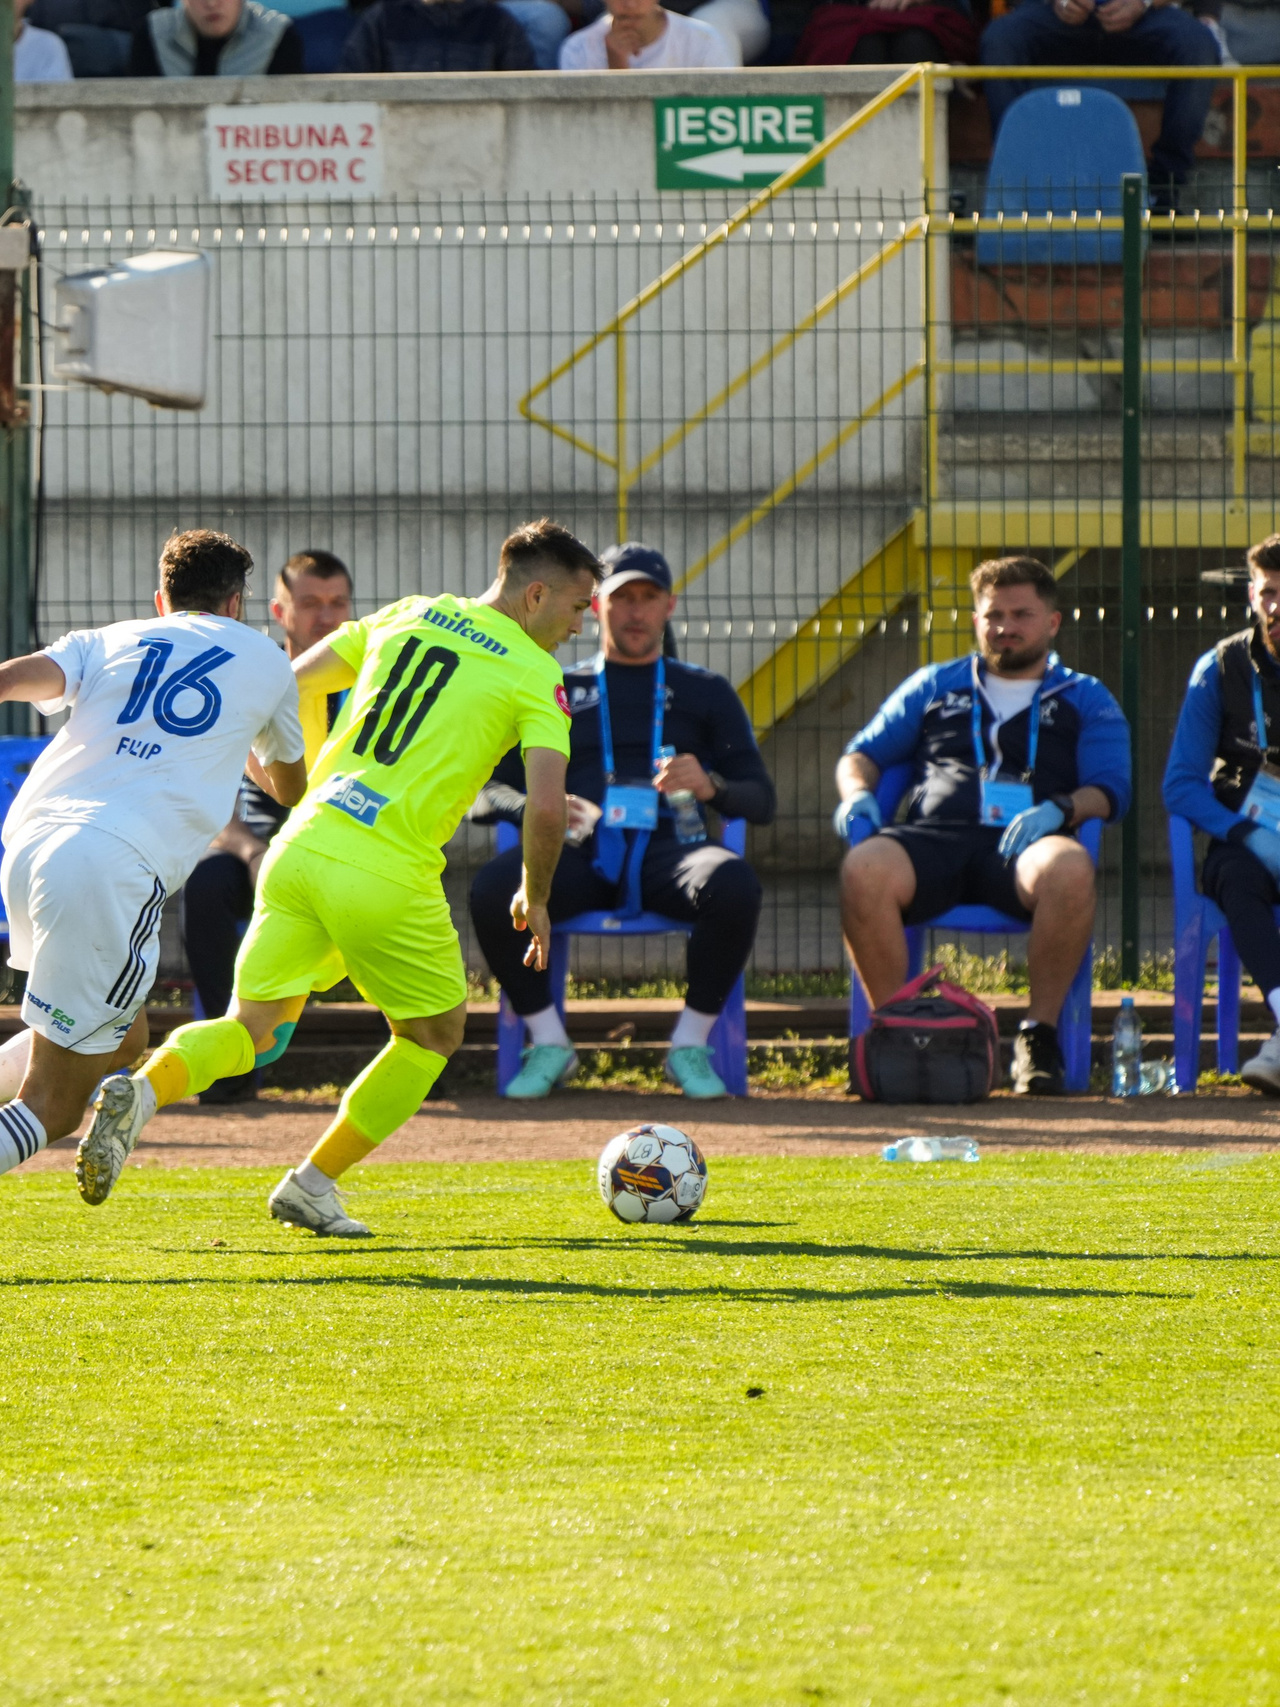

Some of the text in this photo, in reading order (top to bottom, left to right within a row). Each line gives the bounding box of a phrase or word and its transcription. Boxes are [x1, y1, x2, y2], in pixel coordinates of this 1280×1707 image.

[215, 122, 376, 149] TRIBUNA 2
[226, 157, 366, 185] SECTOR C
[116, 637, 237, 738] 16
[352, 635, 461, 767] 10
[51, 1008, 75, 1026] Eco
[51, 1019, 71, 1034] Plus
